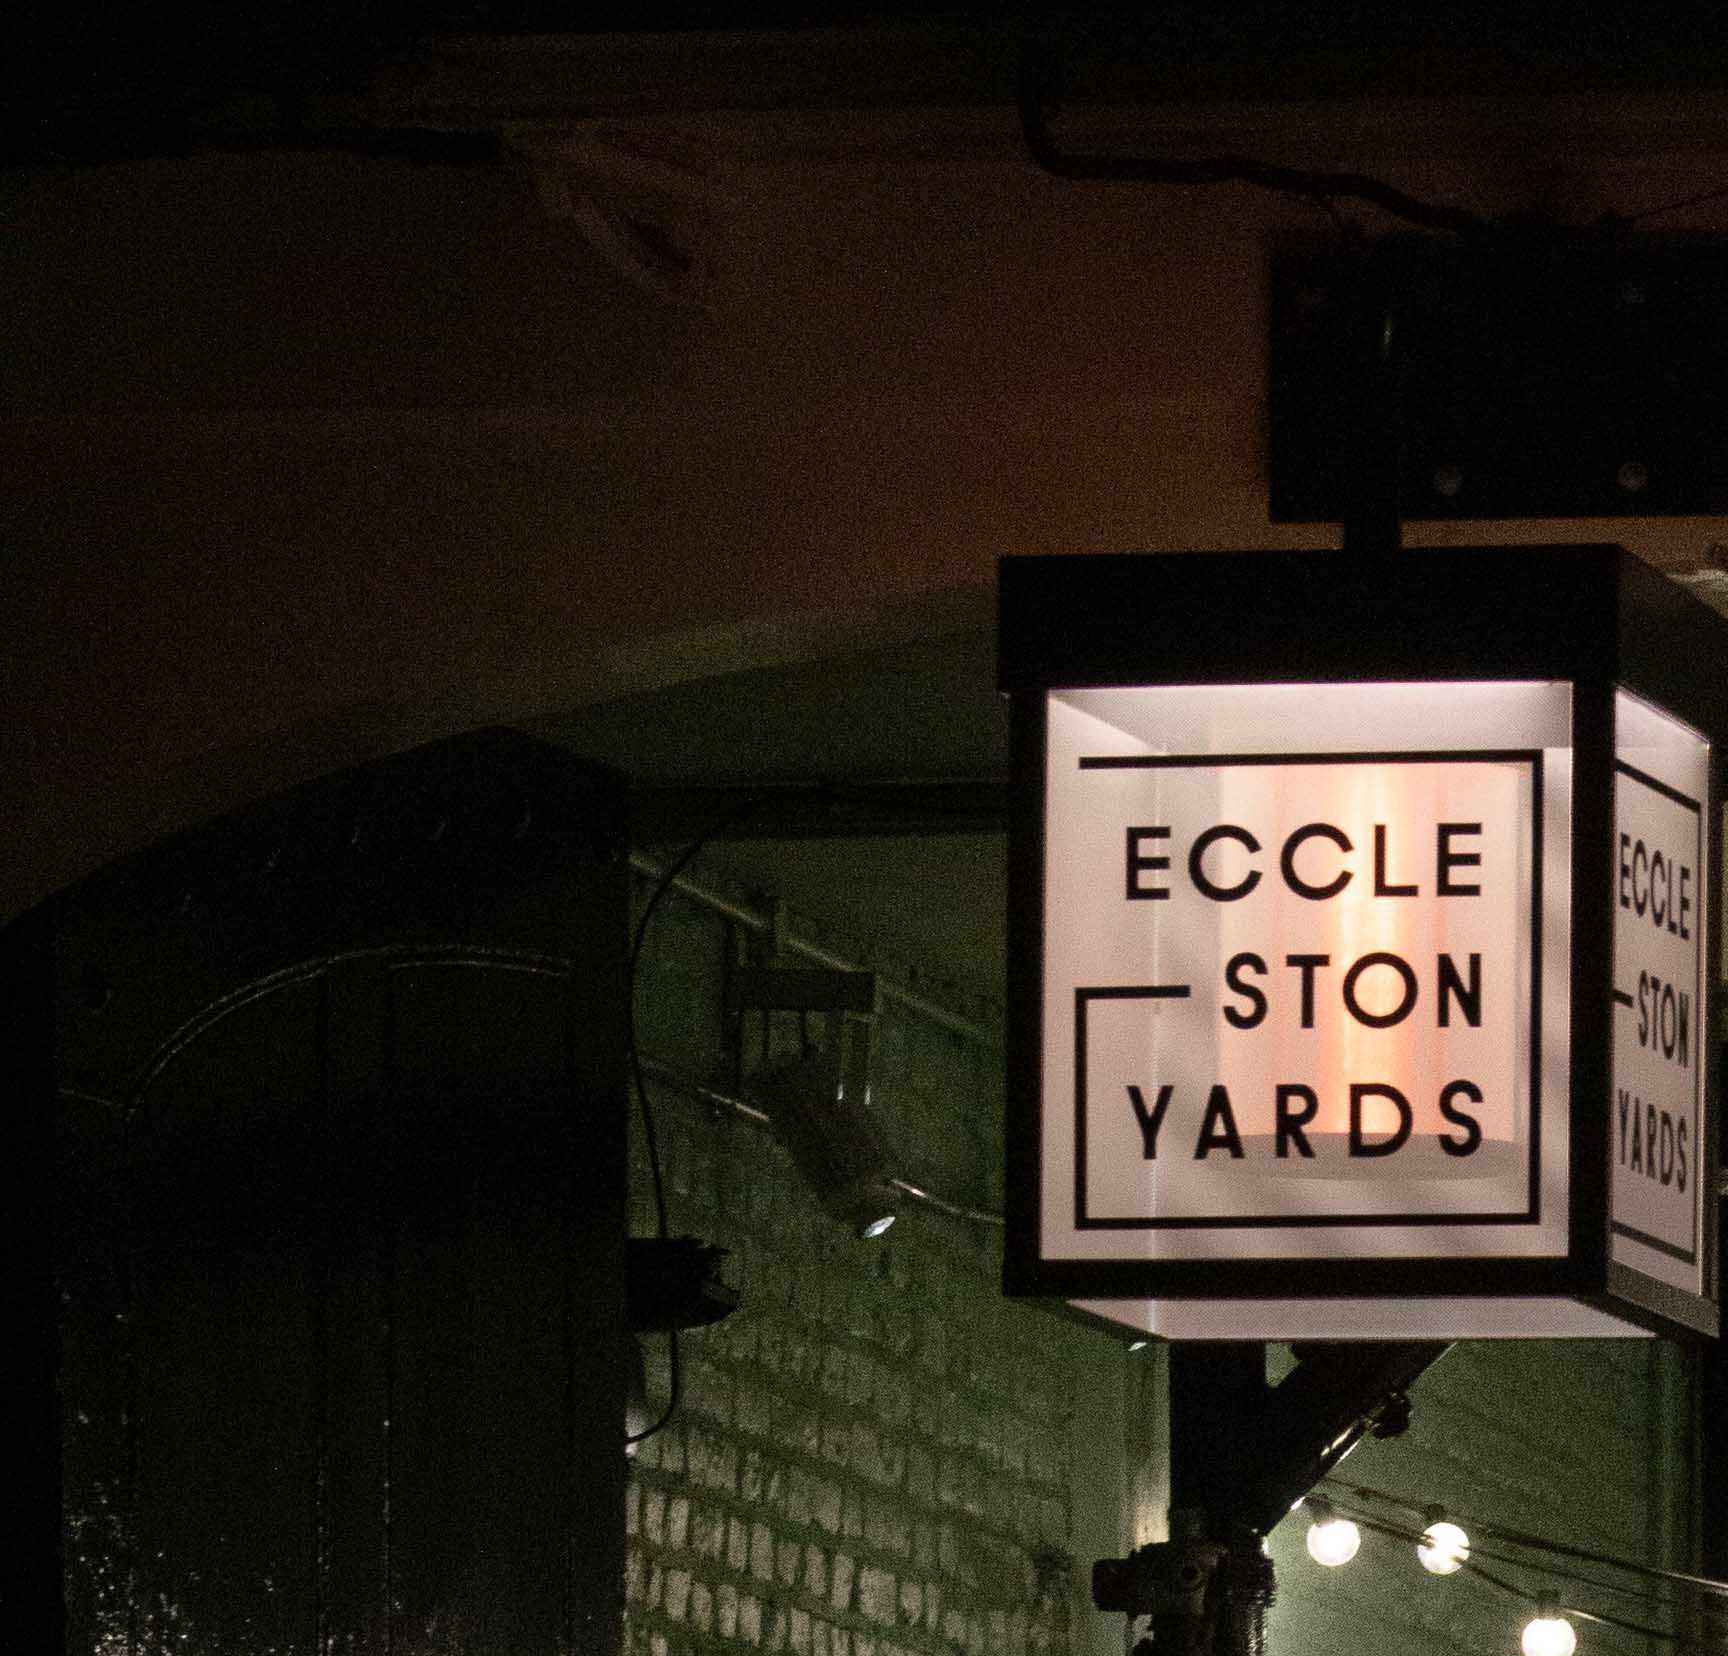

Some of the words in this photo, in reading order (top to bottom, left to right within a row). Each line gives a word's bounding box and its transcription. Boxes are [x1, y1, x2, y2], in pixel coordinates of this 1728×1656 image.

[1125, 823, 1483, 901] ECCLE
[1619, 832, 1691, 941] ECCLE
[1223, 952, 1482, 1029] STON
[1637, 969, 1690, 1069] STON
[1126, 1079, 1484, 1160] YARDS
[1618, 1089, 1689, 1193] YARDS
